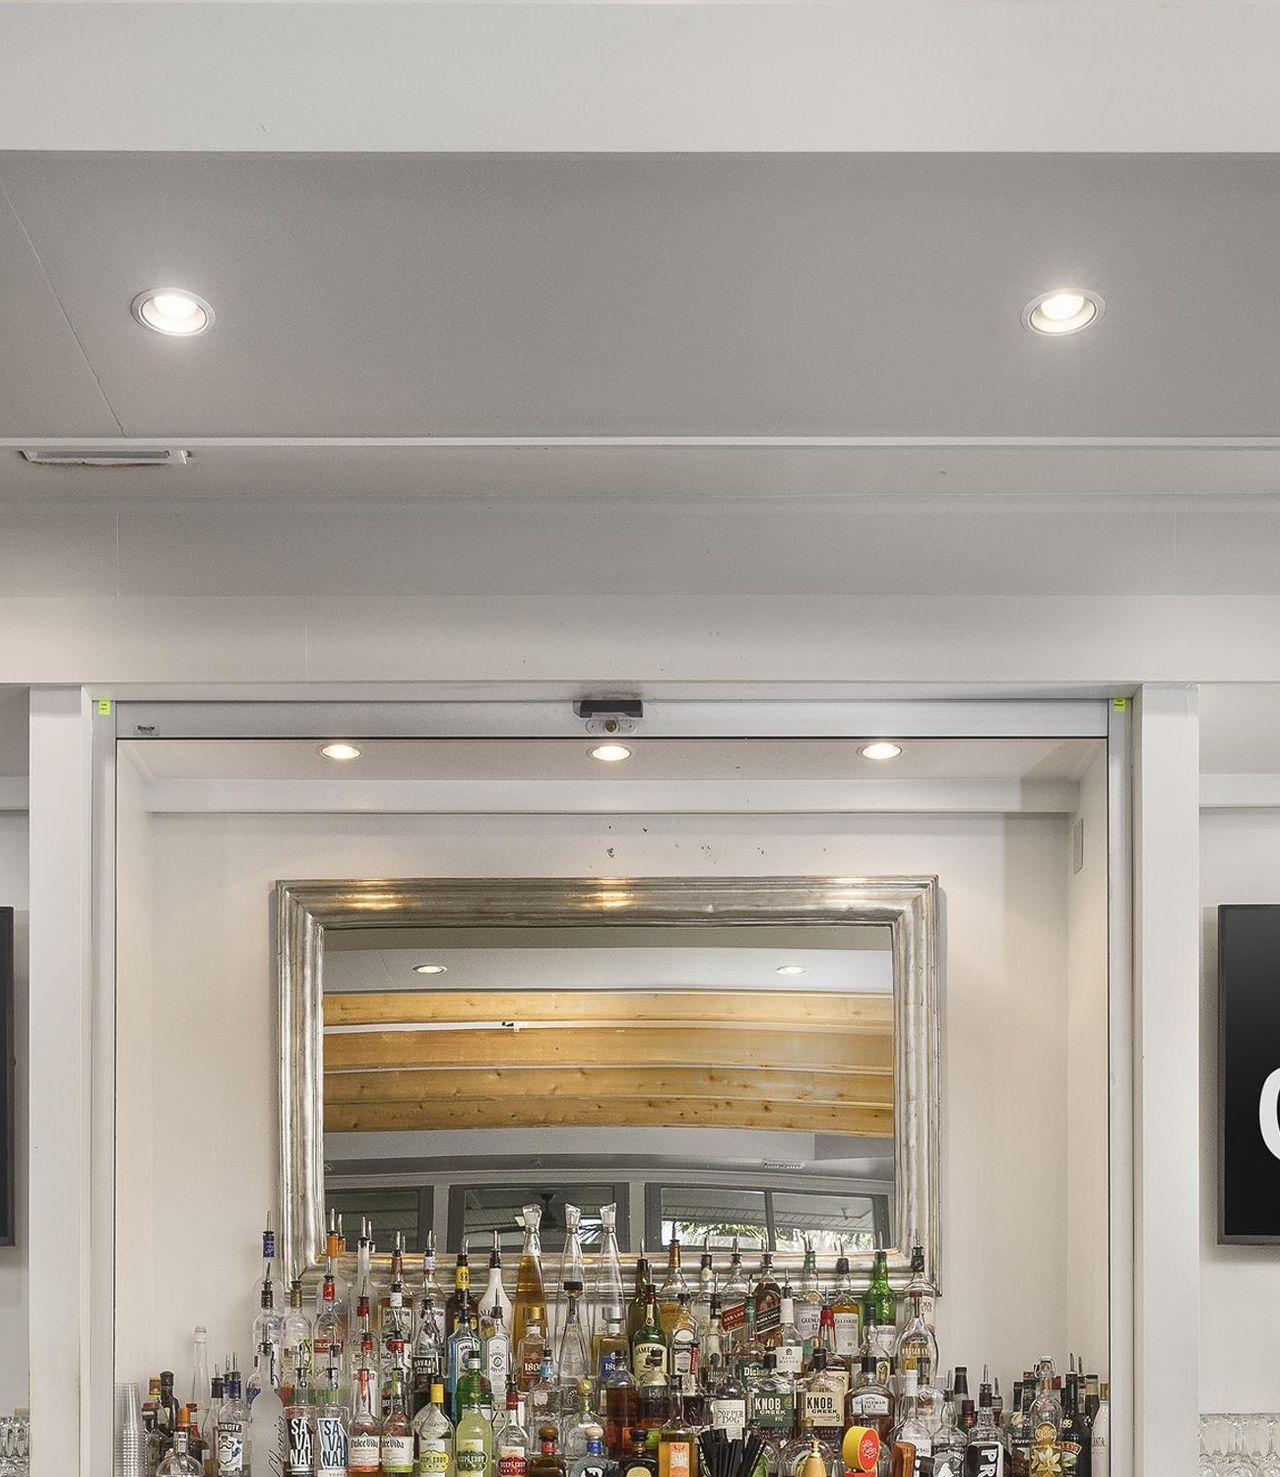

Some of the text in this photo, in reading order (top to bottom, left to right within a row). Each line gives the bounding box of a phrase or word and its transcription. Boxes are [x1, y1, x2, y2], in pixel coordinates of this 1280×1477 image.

[524, 1362, 539, 1372] 180
[755, 1397, 781, 1410] KNOB
[807, 1397, 833, 1409] KNOB
